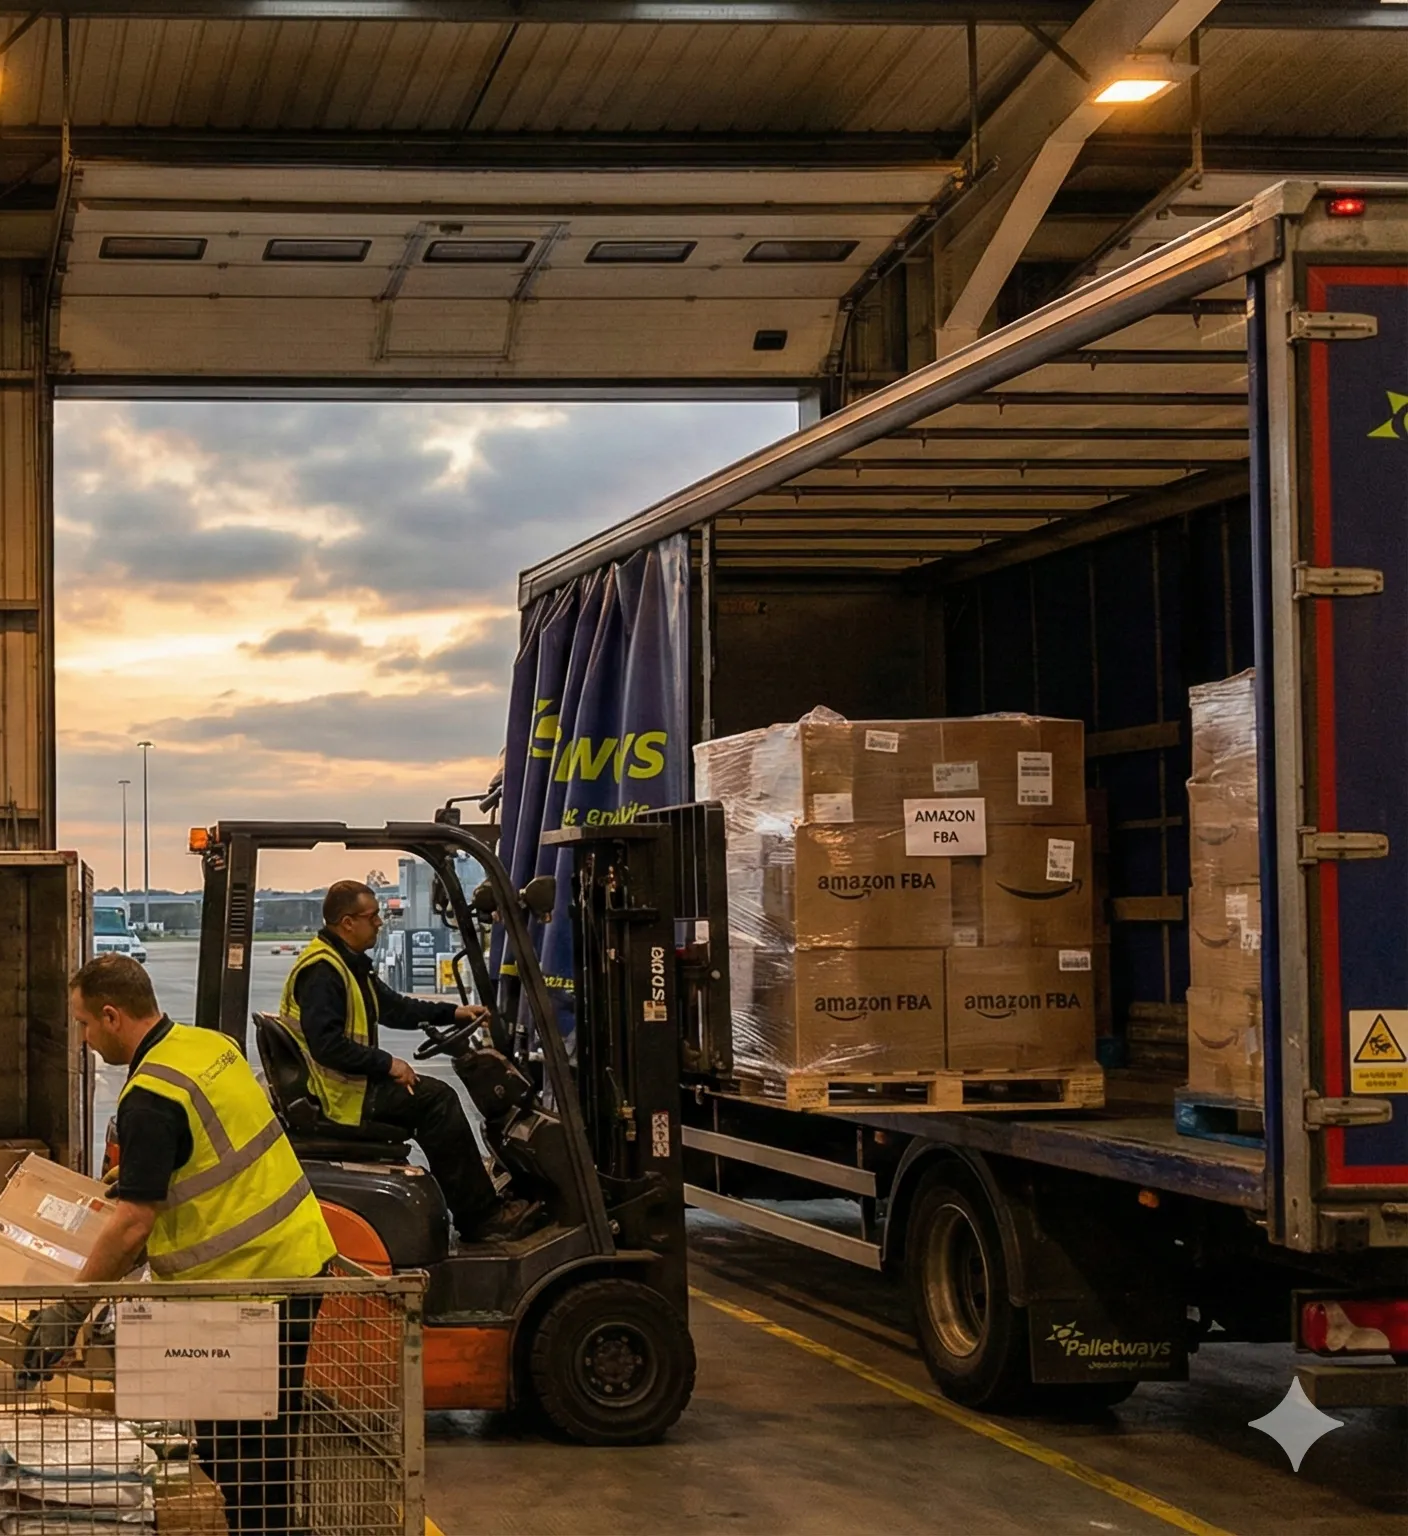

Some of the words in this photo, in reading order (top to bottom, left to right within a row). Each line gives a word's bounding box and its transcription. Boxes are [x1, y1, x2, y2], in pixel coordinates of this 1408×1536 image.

[914, 809, 976, 823] AMAZON
[933, 831, 960, 844] FBA
[817, 874, 896, 890] amazon
[900, 872, 937, 890] FBA
[814, 995, 892, 1013] amazon
[896, 994, 933, 1011] FBA
[964, 993, 1042, 1010] amazon
[1045, 992, 1082, 1010] FBA
[163, 1348, 209, 1359] AMAZON
[211, 1348, 231, 1359] FBA
[1065, 1338, 1172, 1359] Palletways
